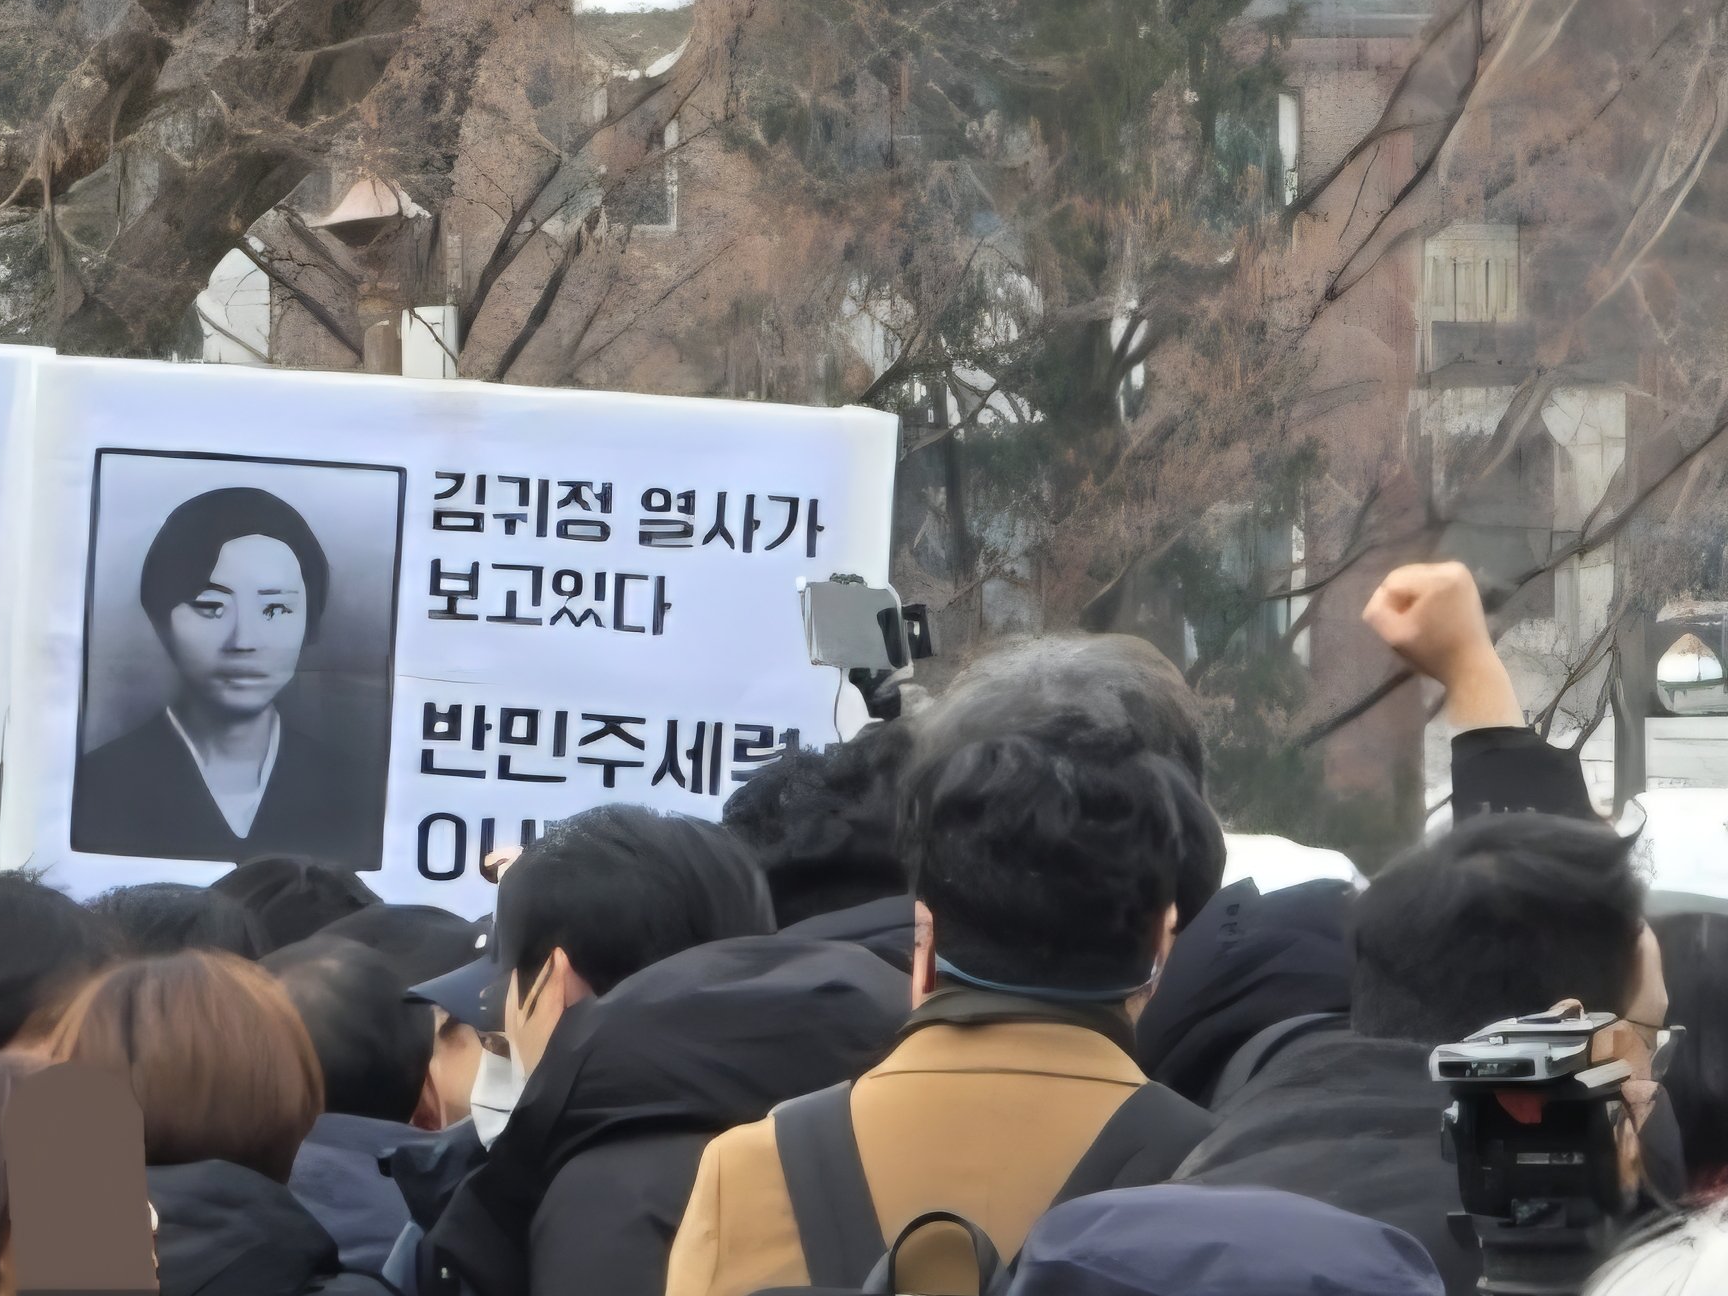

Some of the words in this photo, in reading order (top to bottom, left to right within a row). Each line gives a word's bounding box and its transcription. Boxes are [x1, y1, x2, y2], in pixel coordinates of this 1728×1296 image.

[432, 470, 614, 542] 김귀정
[639, 487, 825, 558] 열사가
[427, 559, 672, 635] 보고있다
